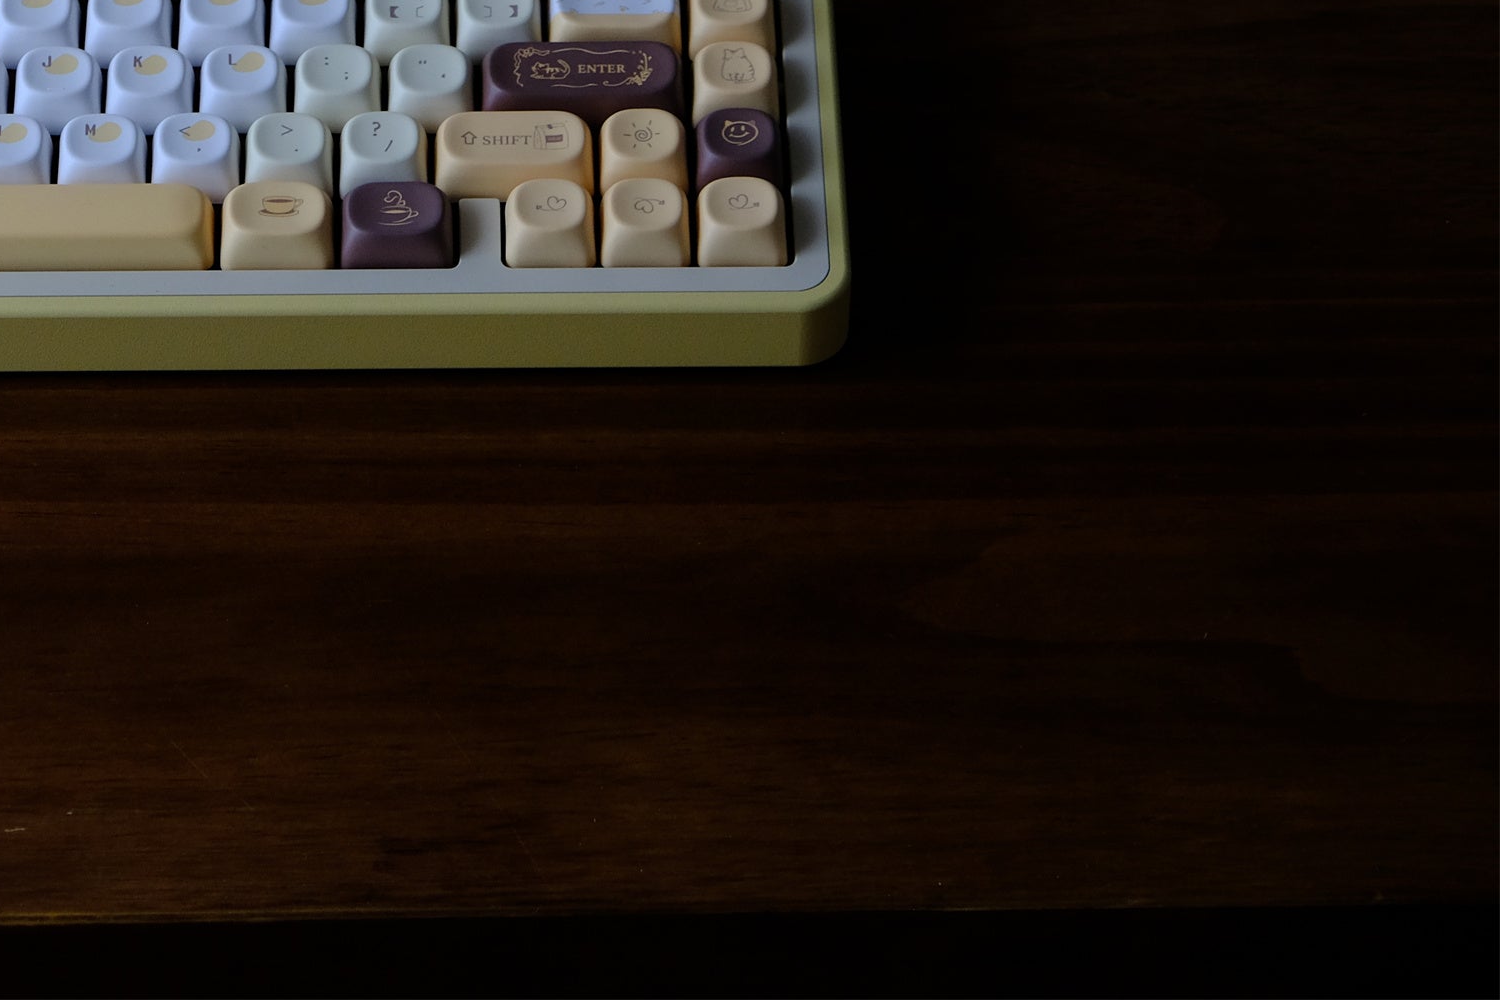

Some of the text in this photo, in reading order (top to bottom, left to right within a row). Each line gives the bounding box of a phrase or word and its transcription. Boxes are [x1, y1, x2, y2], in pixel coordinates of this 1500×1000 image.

[42, 56, 52, 68] J
[134, 56, 142, 67] K
[229, 54, 237, 66] L
[577, 64, 626, 74] ENTER
[85, 124, 96, 135] M
[483, 135, 532, 146] SHIFT
